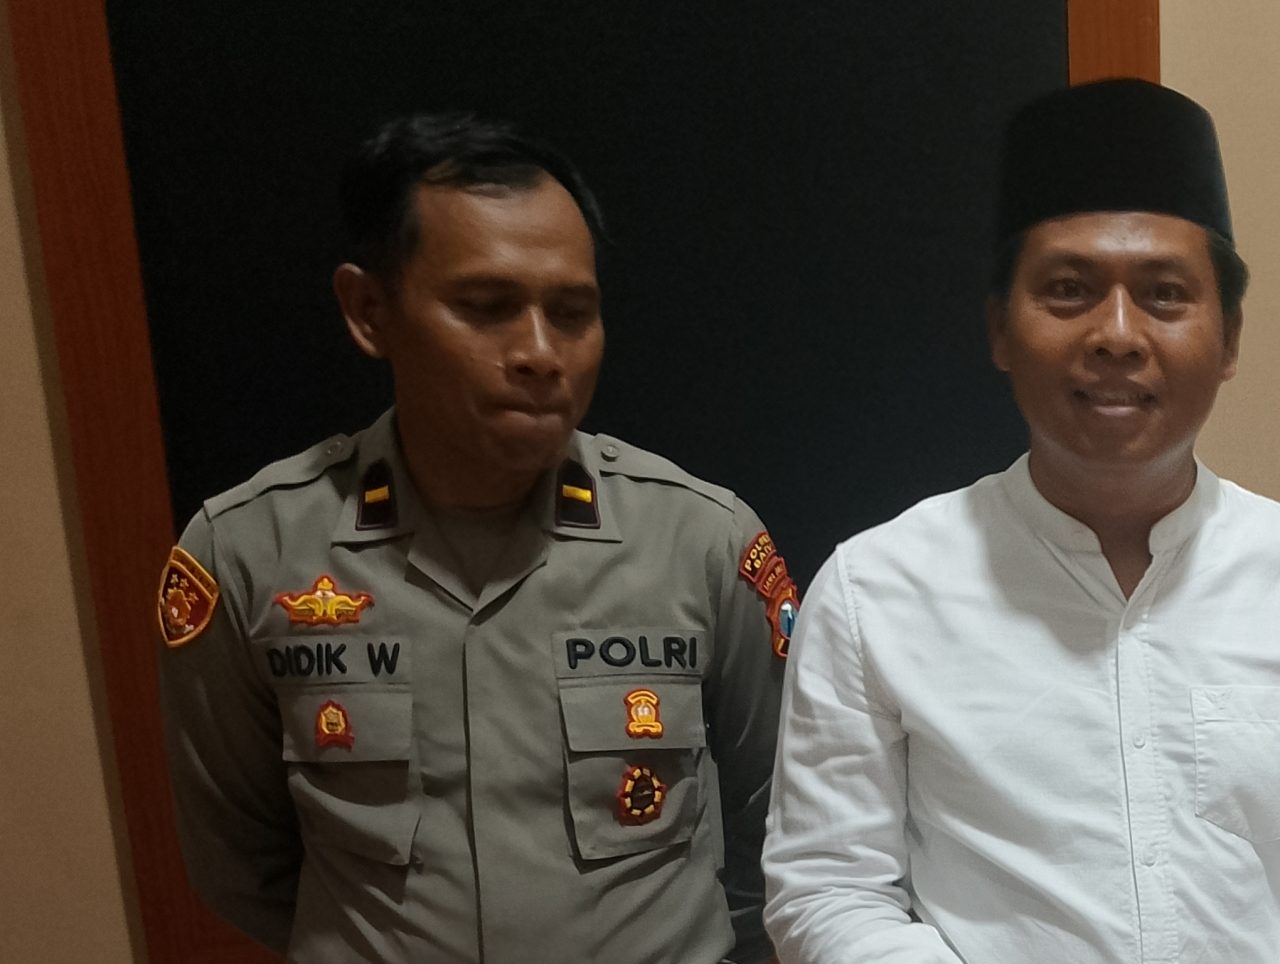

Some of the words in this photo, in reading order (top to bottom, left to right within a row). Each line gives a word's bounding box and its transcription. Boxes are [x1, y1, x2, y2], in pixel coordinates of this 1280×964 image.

[267, 642, 348, 677] DIDIK
[367, 642, 401, 678] W
[566, 635, 697, 670] POLRI
